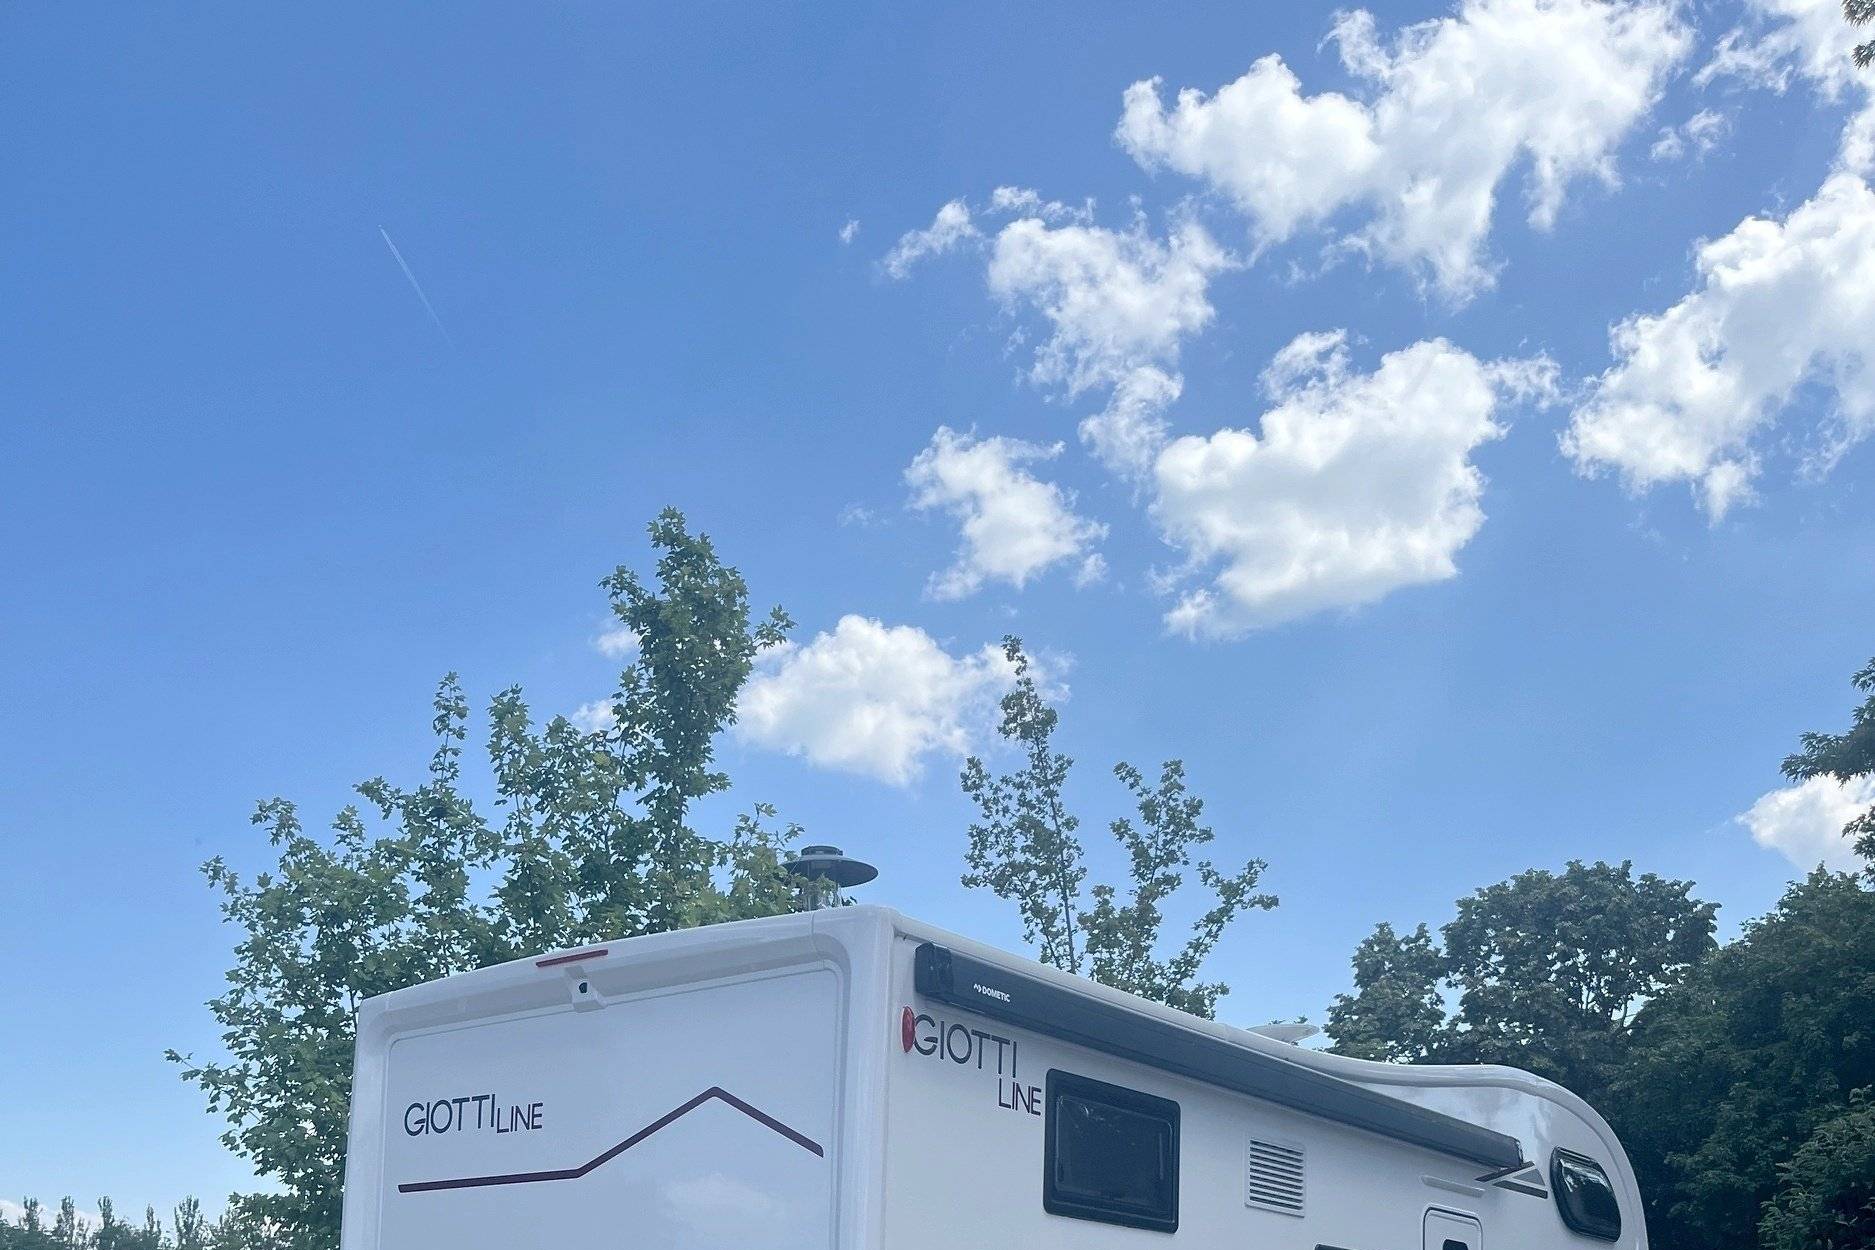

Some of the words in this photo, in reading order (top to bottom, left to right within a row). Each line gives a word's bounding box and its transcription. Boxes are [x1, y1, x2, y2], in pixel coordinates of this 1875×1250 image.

[982, 985, 1010, 1003] DOMETIC
[914, 1014, 1017, 1079] GIOTTI
[998, 1078, 1042, 1116] LINE
